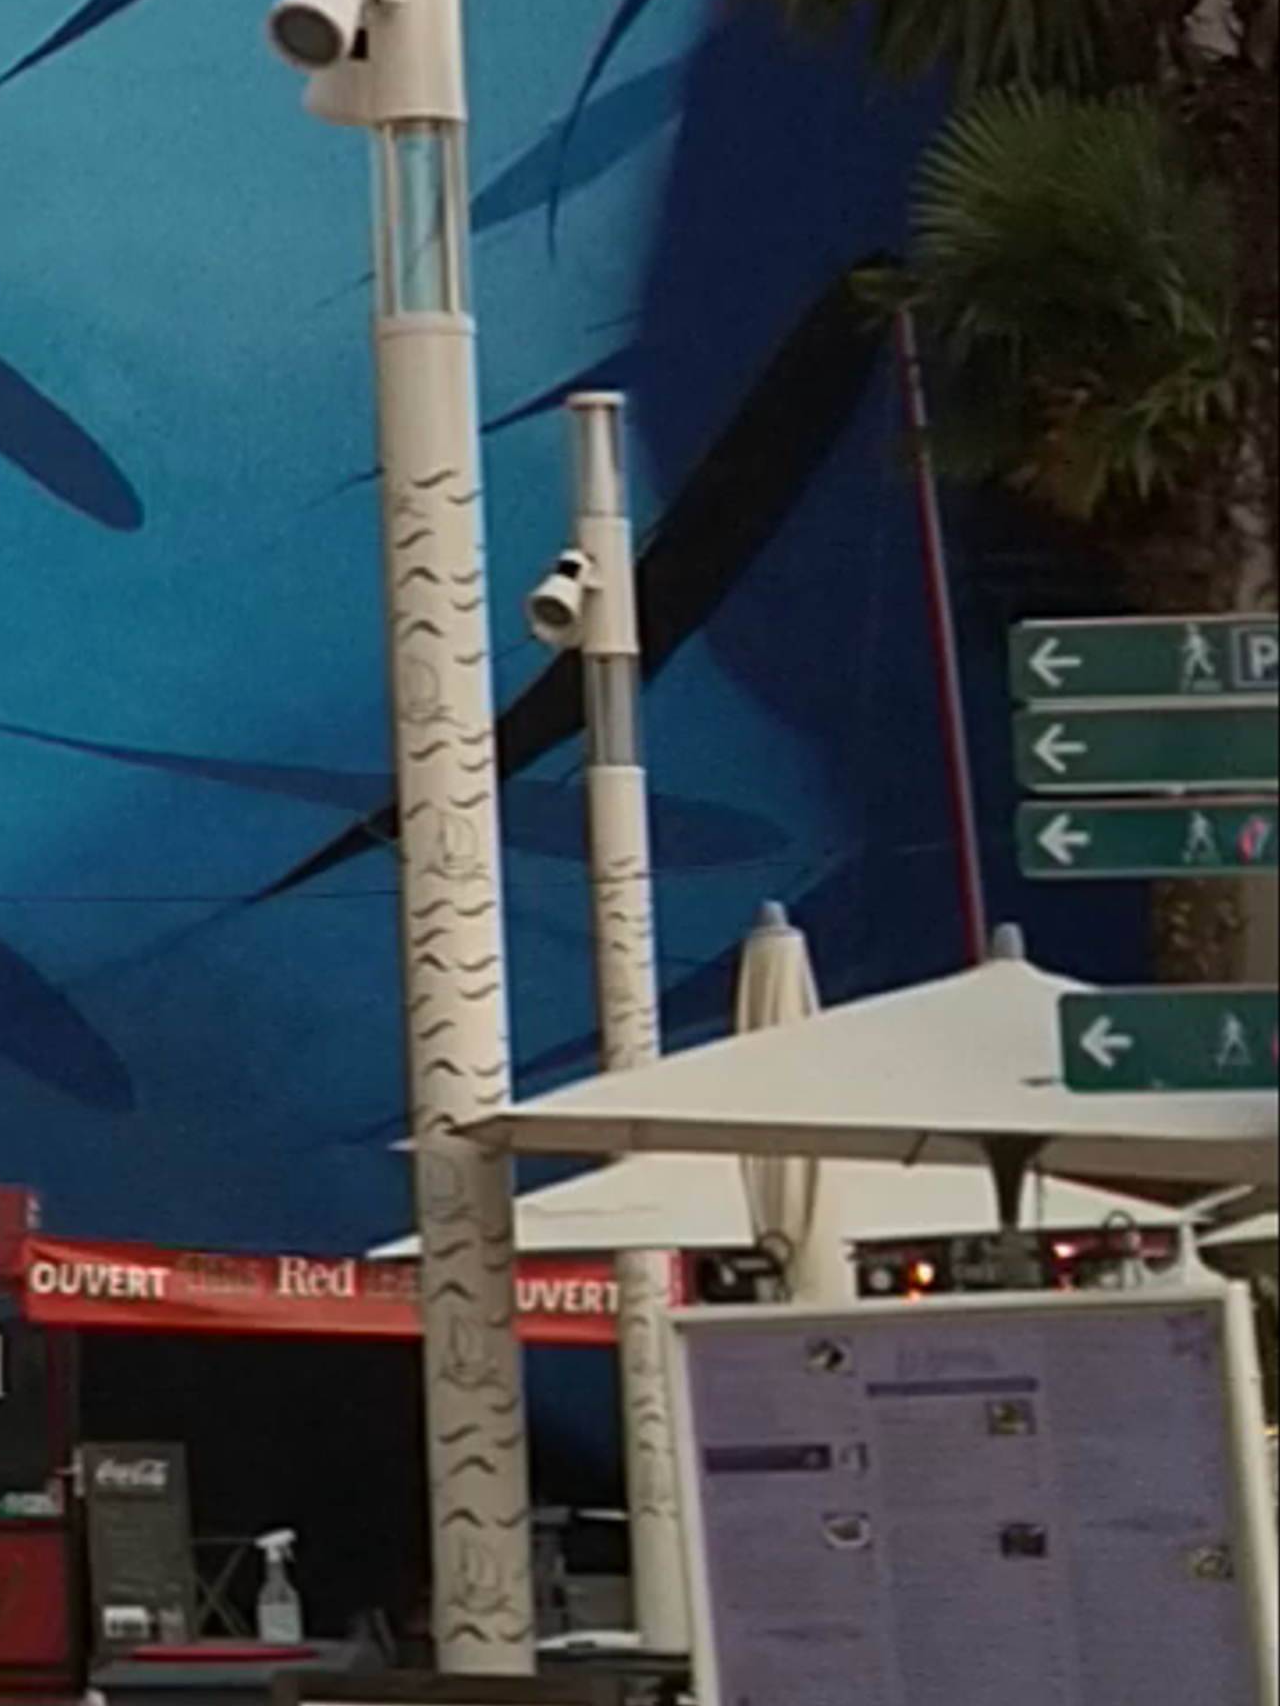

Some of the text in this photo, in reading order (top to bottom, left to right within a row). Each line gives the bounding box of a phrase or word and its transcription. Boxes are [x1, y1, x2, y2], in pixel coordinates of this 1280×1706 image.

[29, 1262, 171, 1298] OUVERT
[276, 1256, 357, 1298] Red
[514, 1278, 621, 1314] UVERT
